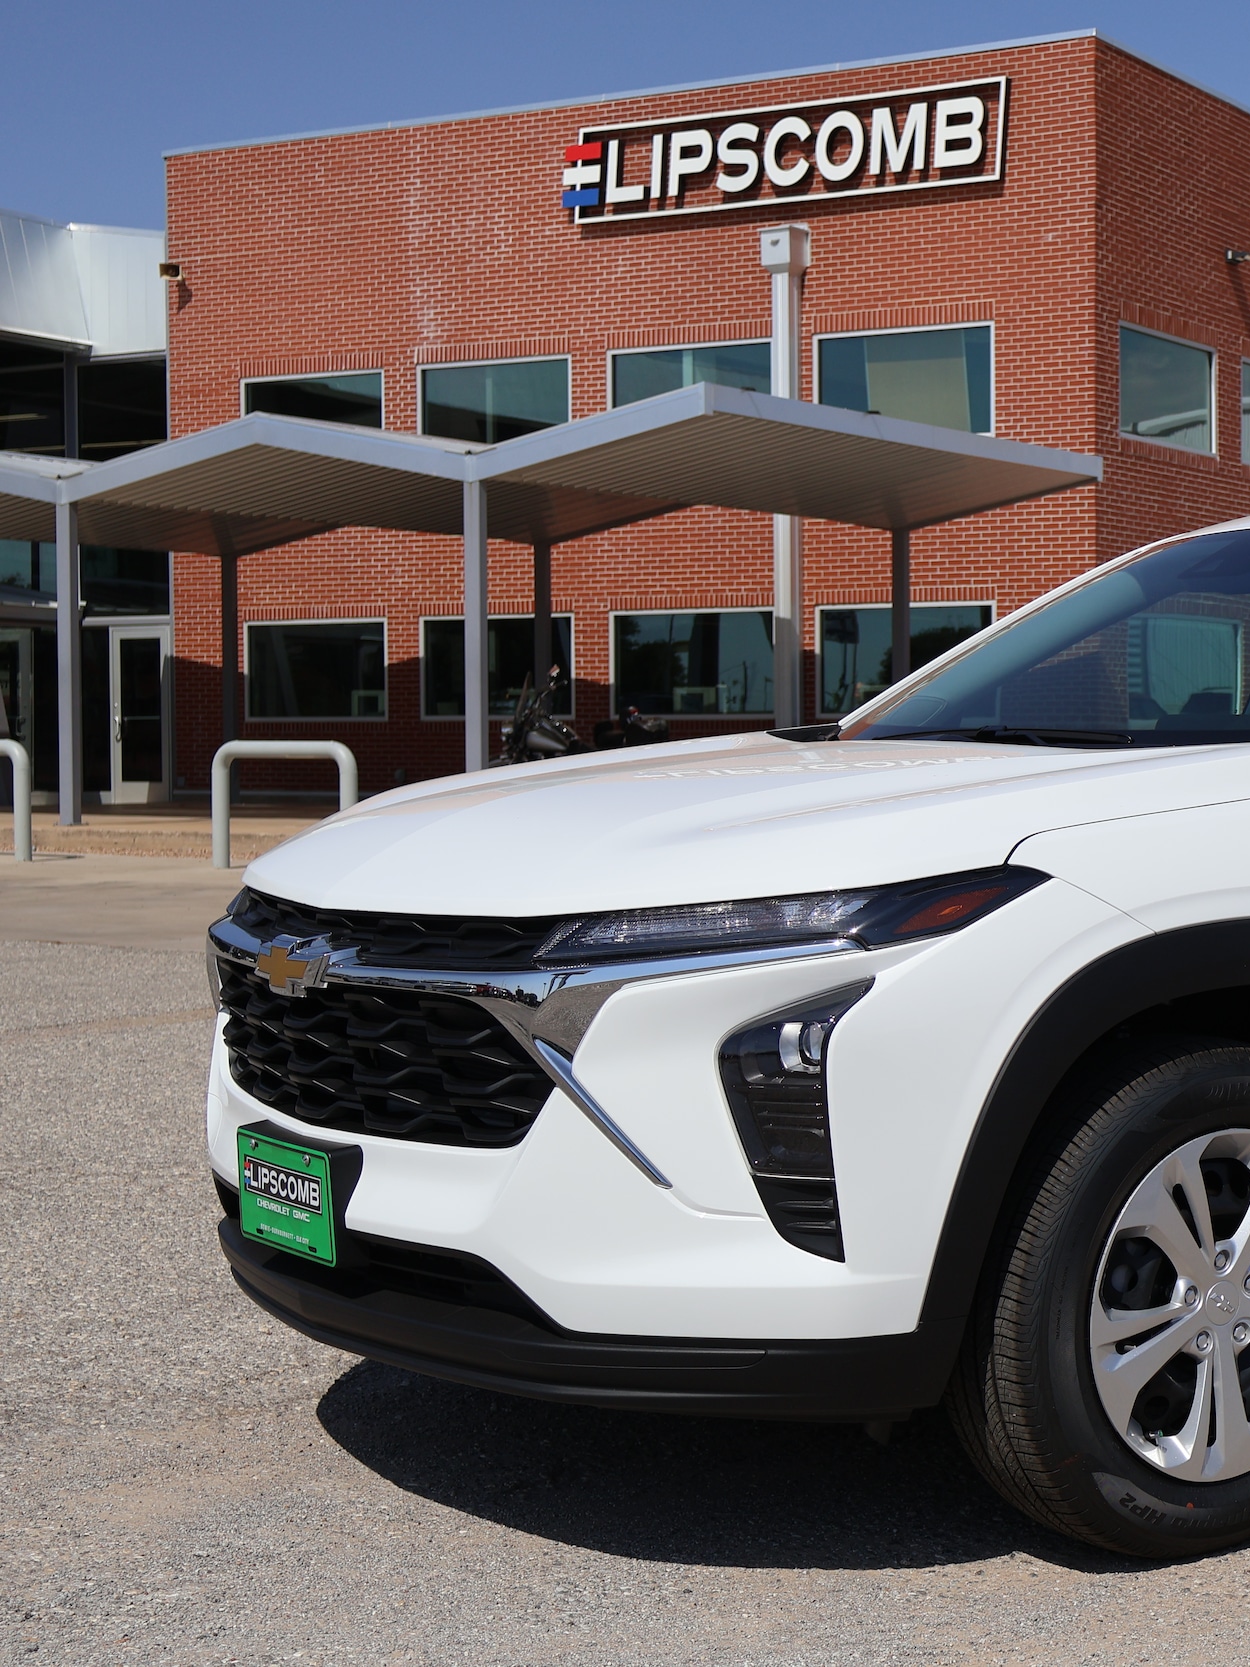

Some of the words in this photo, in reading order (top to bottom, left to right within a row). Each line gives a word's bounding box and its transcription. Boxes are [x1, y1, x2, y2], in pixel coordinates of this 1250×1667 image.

[604, 96, 986, 204] LIPSCOMB
[250, 1163, 320, 1207] LIPSCOMB
[256, 1197, 290, 1217] CHEVROLET
[292, 1209, 311, 1223] GMC
[1118, 1491, 1168, 1528] HP2
